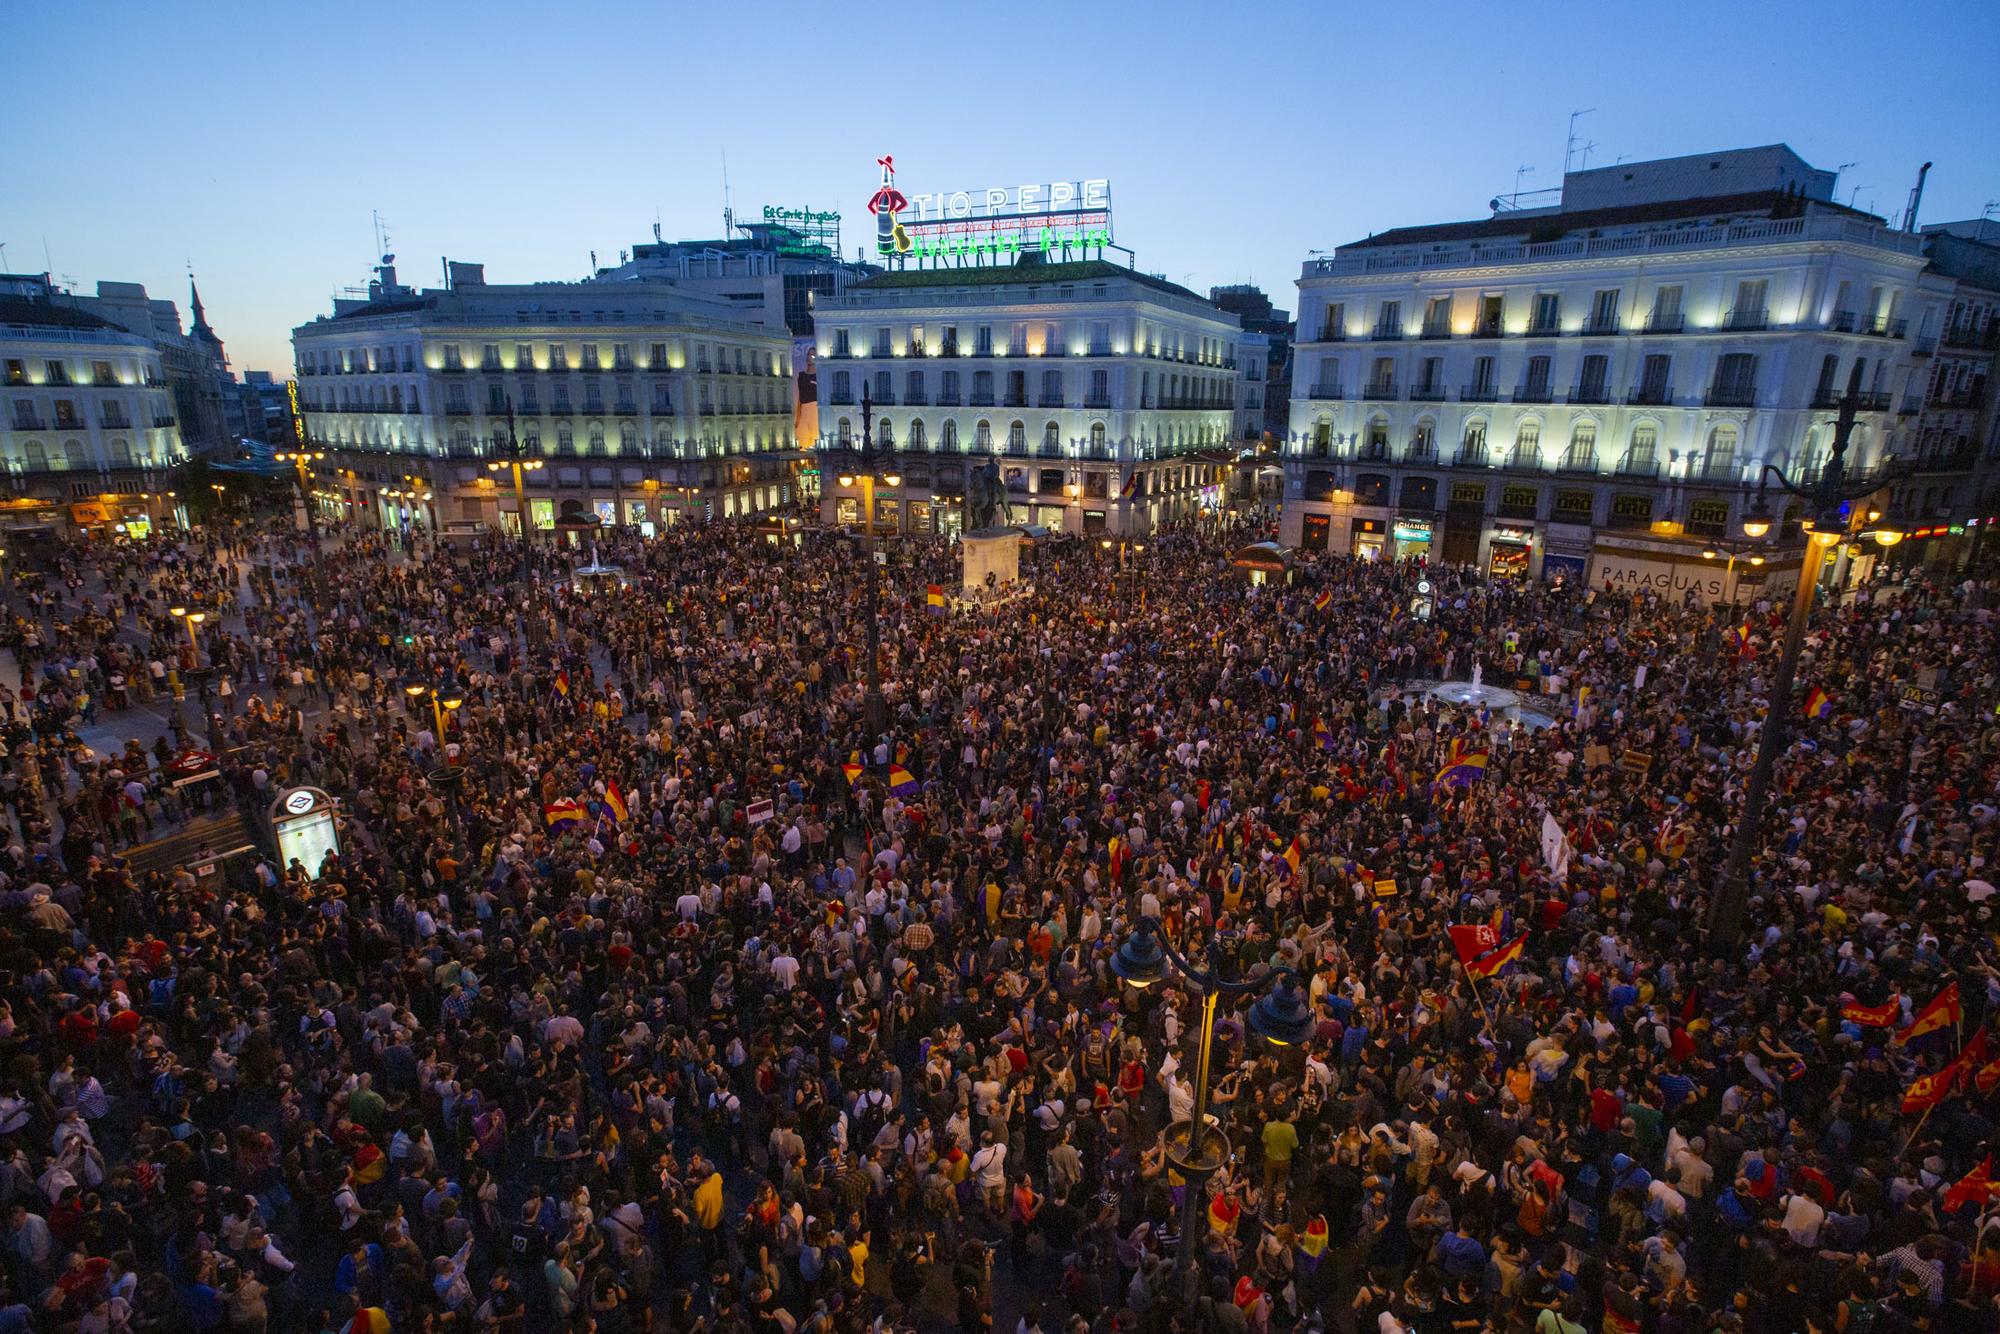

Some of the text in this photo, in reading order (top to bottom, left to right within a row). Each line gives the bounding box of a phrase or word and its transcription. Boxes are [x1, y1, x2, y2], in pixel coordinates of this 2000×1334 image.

[912, 179, 1108, 221] TIO PEPE
[763, 205, 775, 218] El
[776, 206, 803, 219] Corte
[1453, 489, 1485, 501] ORO
[1503, 493, 1537, 506] ORO
[1557, 498, 1592, 510] ORO
[1614, 502, 1652, 516] ORO
[1306, 515, 1329, 525] Orange
[1692, 508, 1727, 522] ORO
[1398, 521, 1430, 531] CHANGE
[1602, 567, 1720, 595] PARAGUAS
[182, 758, 204, 767] Metro
